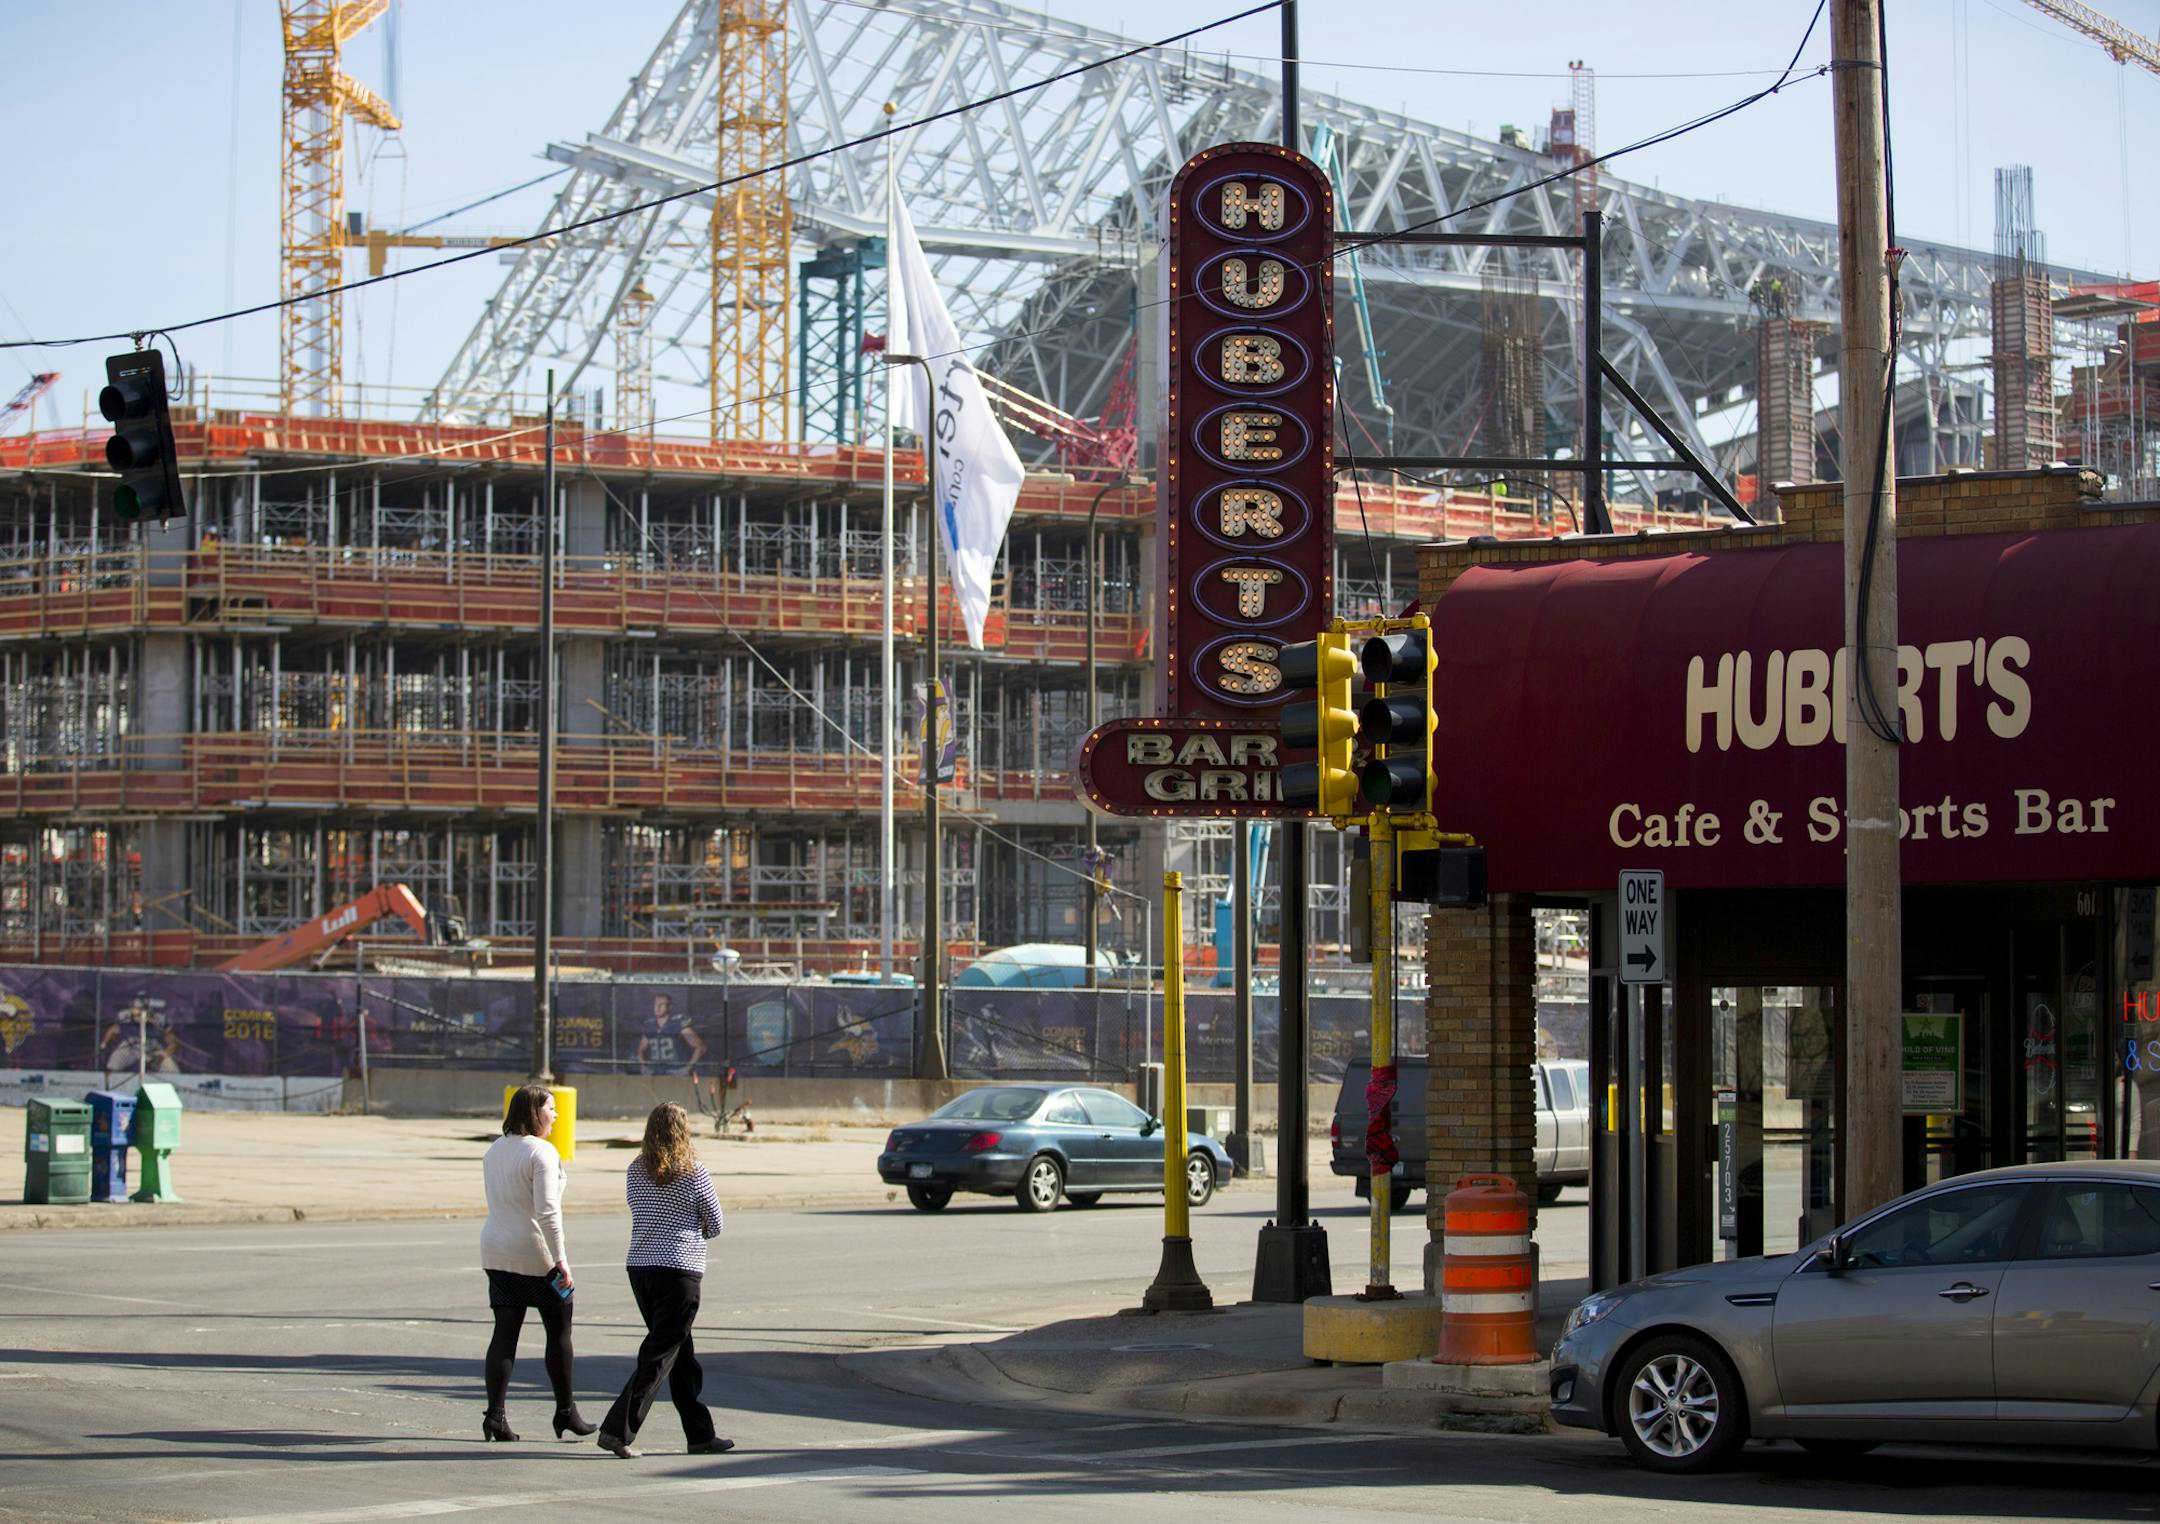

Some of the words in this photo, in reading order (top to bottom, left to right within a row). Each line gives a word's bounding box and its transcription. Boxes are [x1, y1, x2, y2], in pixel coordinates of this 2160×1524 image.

[1127, 734, 1279, 767] BAR
[1608, 802, 1721, 848] Cafe
[1743, 799, 1783, 844] &
[2014, 788, 2116, 834] Bar
[1626, 878, 1657, 904] ONE
[321, 905, 358, 936] Lull
[1625, 910, 1658, 935] WAY
[2125, 1040, 2143, 1071] &
[1724, 1122, 1732, 1203] 25703
